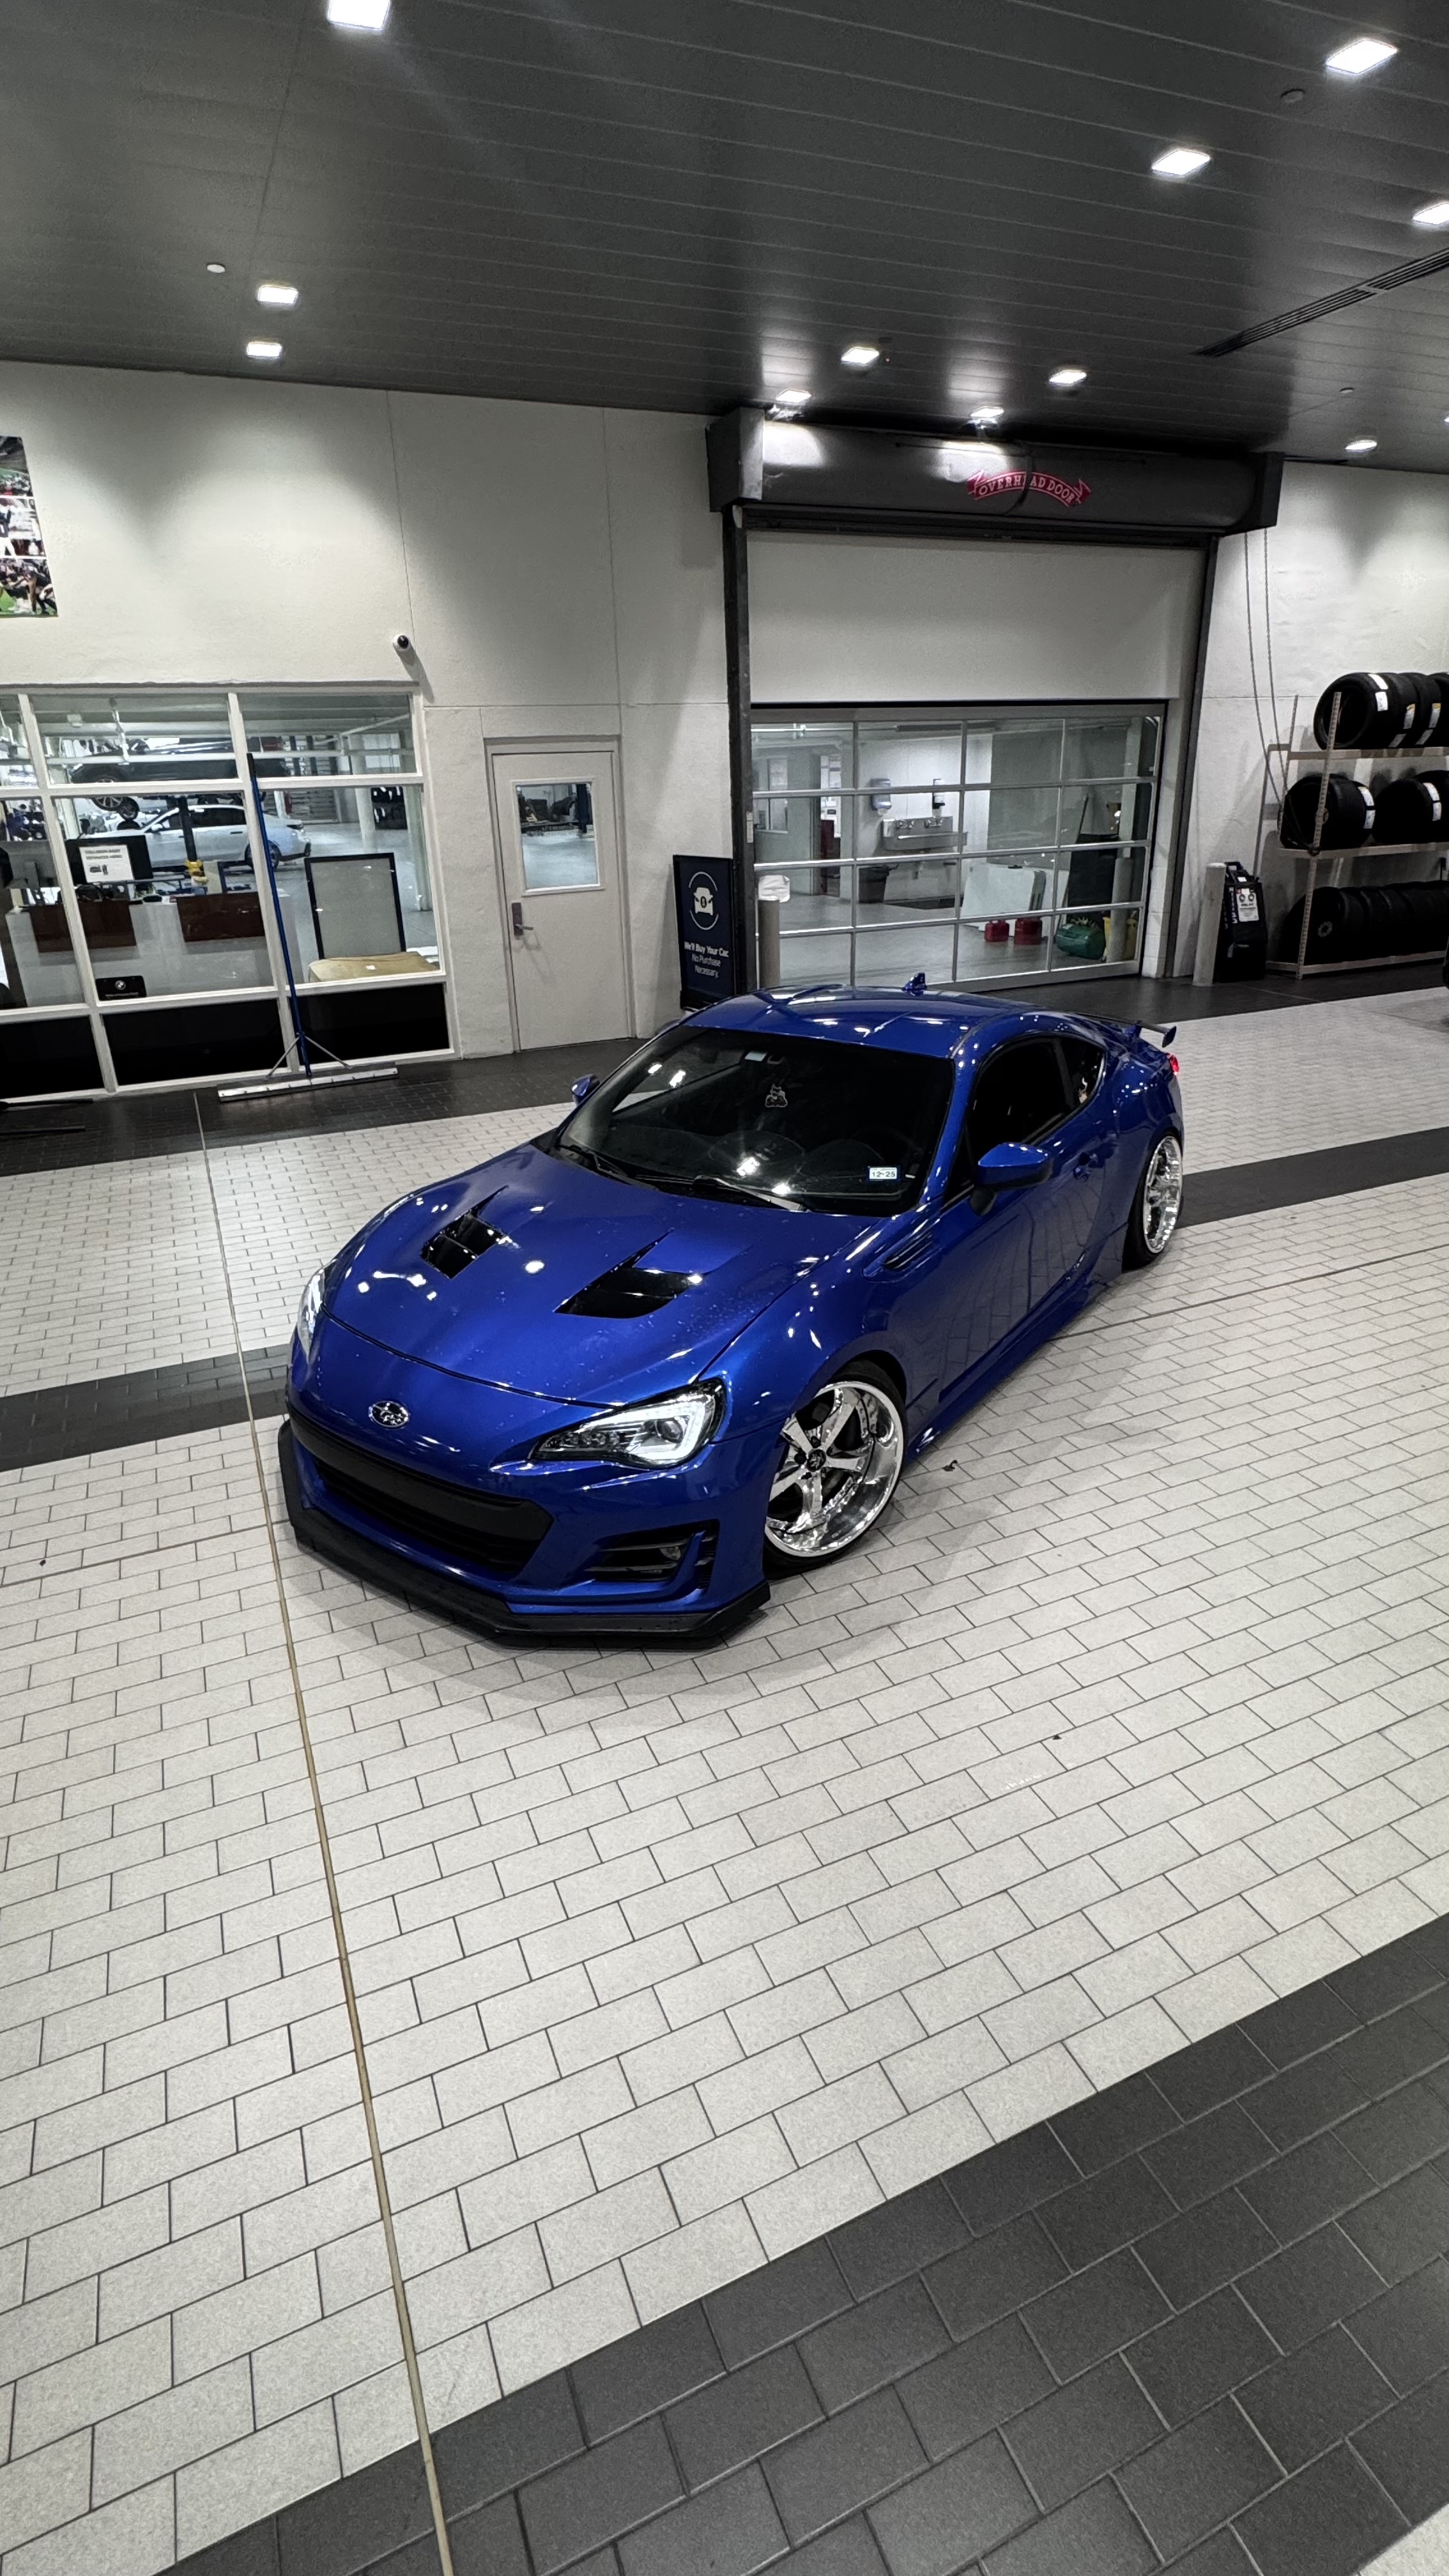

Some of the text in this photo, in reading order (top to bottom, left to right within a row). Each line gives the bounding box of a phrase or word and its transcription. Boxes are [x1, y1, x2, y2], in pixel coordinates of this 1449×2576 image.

[1047, 479, 1075, 503] DOOR
[696, 943, 706, 954] Buy
[707, 946, 718, 955] Your
